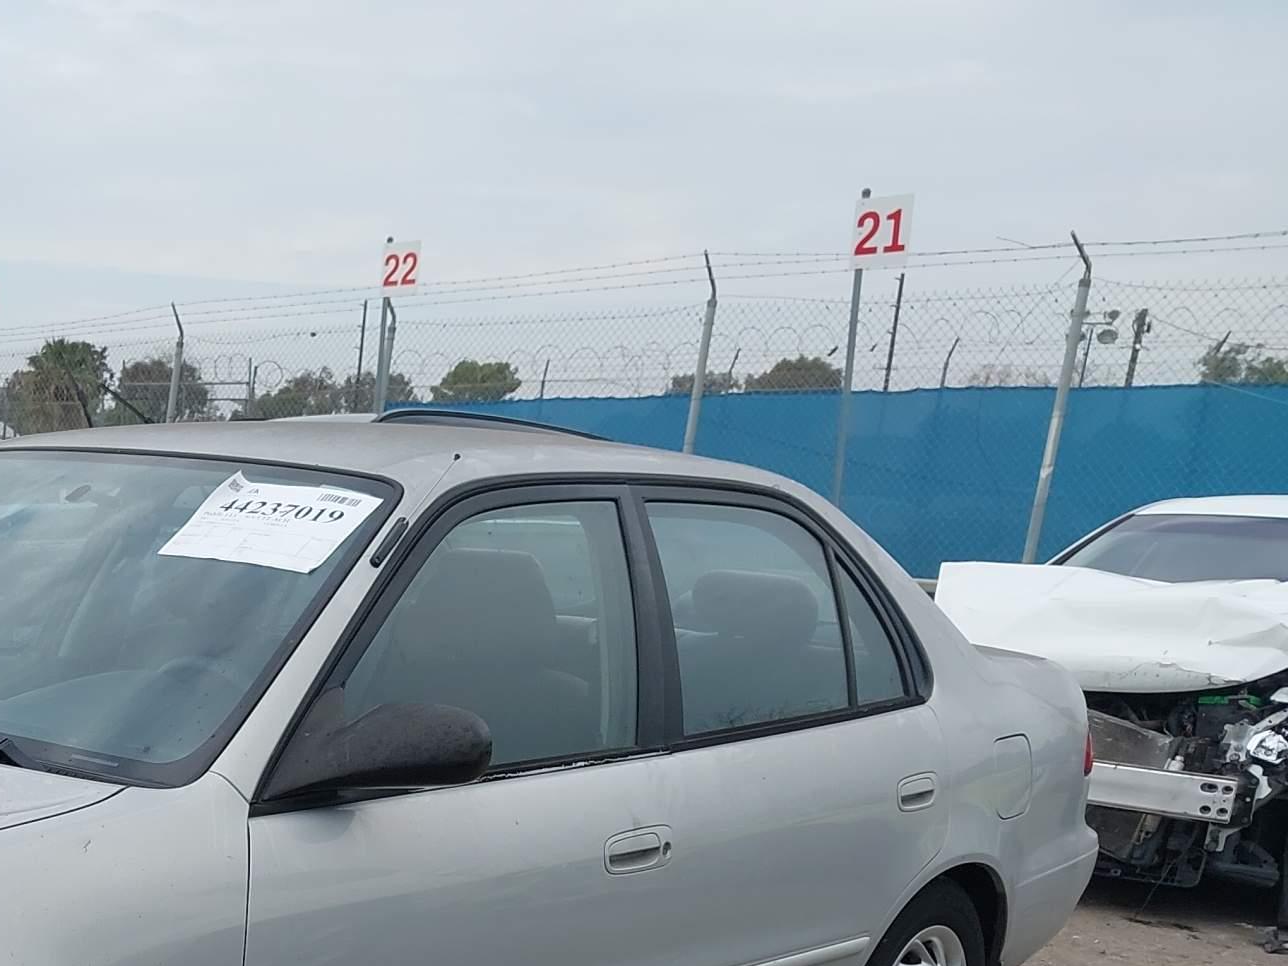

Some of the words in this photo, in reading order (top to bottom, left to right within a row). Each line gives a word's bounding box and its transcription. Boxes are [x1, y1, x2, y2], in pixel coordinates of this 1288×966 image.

[854, 208, 905, 256] 21
[383, 252, 418, 286] 22
[219, 498, 345, 524] 44237019
